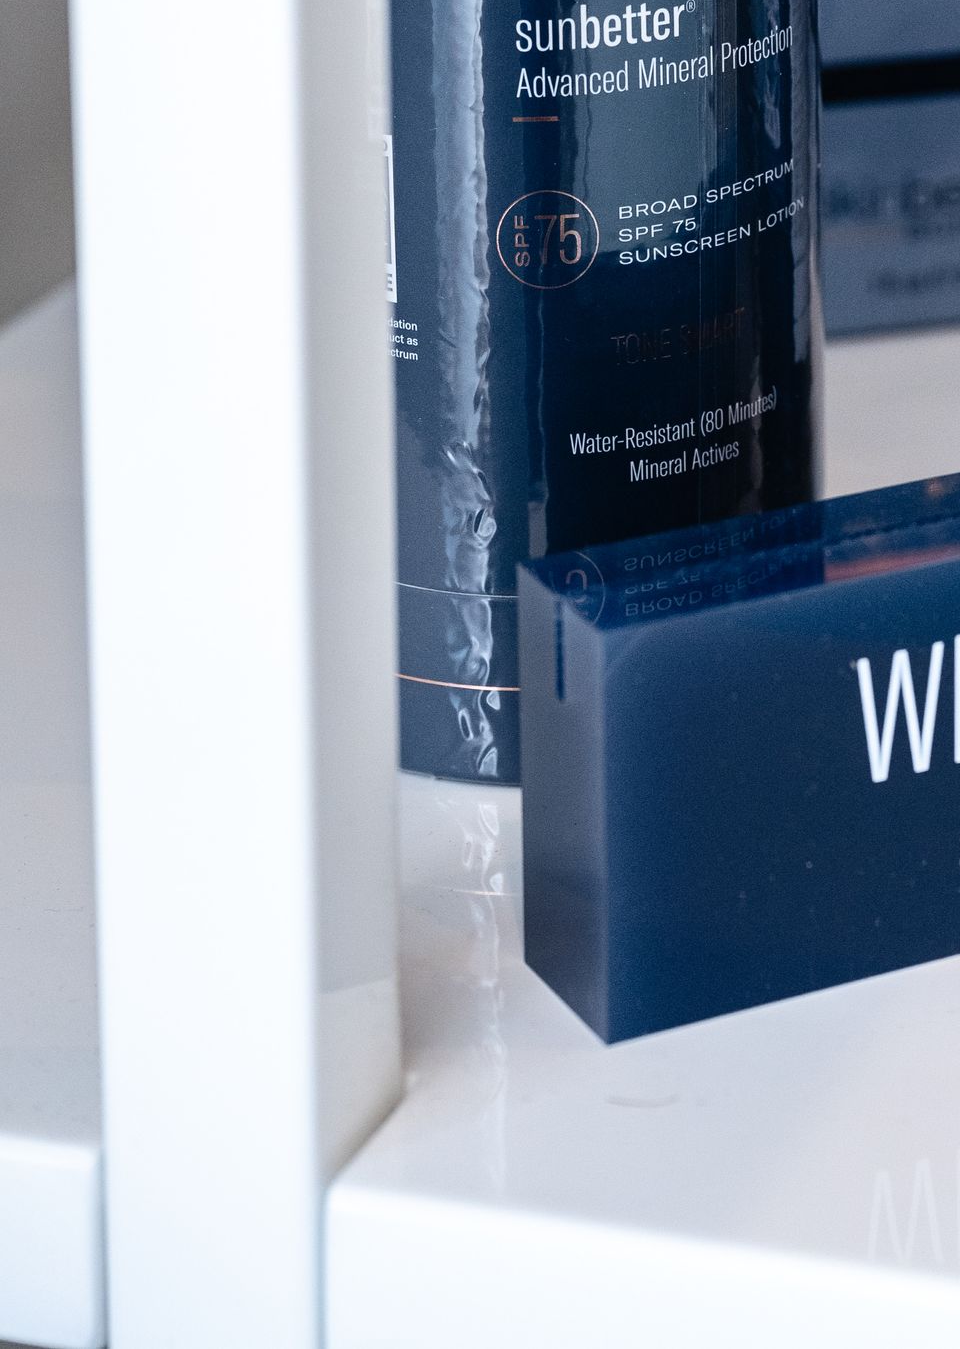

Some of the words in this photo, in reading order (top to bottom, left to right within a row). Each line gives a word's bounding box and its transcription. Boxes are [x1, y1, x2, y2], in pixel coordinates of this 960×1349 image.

[516, 62, 629, 99] Advanced
[638, 55, 713, 87] Mineral
[721, 22, 793, 73] Protection
[618, 194, 698, 220] BROAD
[705, 158, 795, 204] SPECTRUM
[513, 214, 530, 268] SPF
[534, 213, 582, 265] 75
[618, 223, 664, 243] SPF
[672, 217, 697, 234] 75
[618, 224, 752, 266] SUNSCREEN
[757, 195, 805, 232] LOTION
[406, 338, 419, 347] as
[569, 418, 696, 456] Water-Resistant
[700, 407, 725, 438] (80
[727, 385, 777, 429] Minutes)
[629, 453, 687, 483] Mineral
[691, 440, 740, 469] Actives
